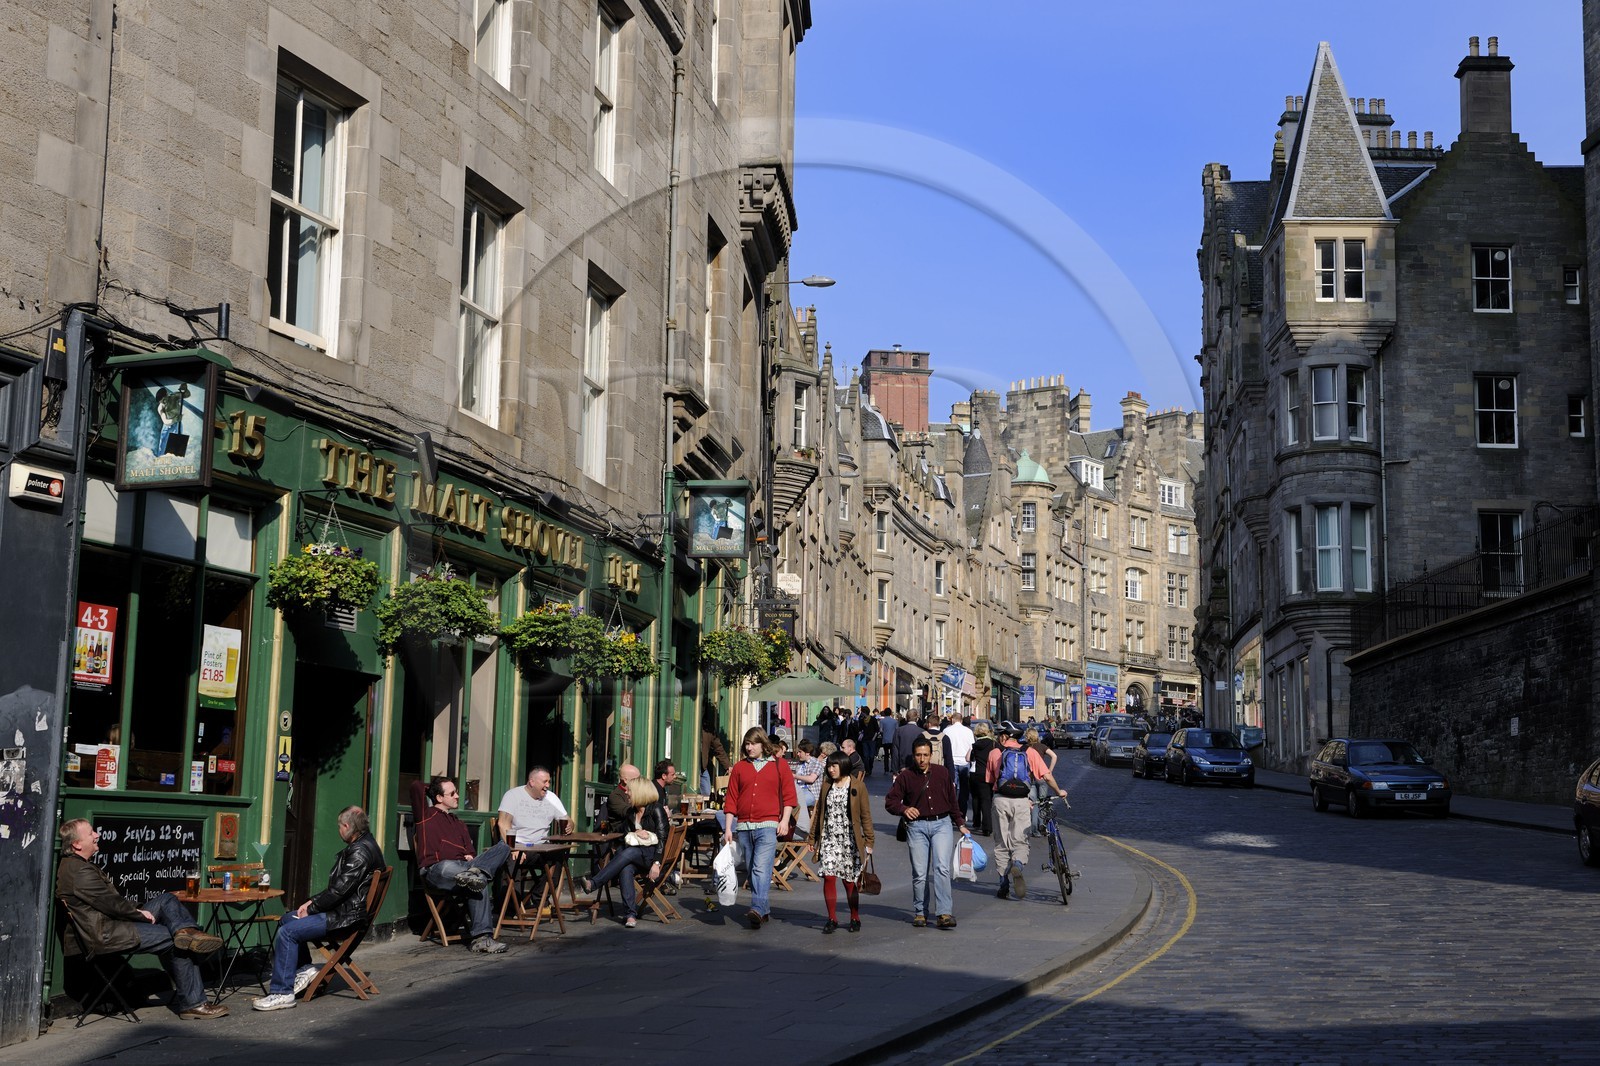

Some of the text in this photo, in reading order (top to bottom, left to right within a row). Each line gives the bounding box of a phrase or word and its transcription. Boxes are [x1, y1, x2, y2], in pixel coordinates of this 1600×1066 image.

[130, 465, 197, 478] MALT SHOVEL
[27, 479, 49, 489] pointer
[319, 438, 590, 573] THE MALT SHOVEL
[81, 606, 93, 627] 4
[97, 608, 109, 630] 3
[204, 650, 223, 660] Pint of
[203, 659, 223, 668] Fosters
[202, 668, 224, 682] £1.85
[113, 852, 129, 863] our
[132, 846, 165, 863] delicious
[119, 868, 150, 887] specials
[155, 865, 186, 879] available
